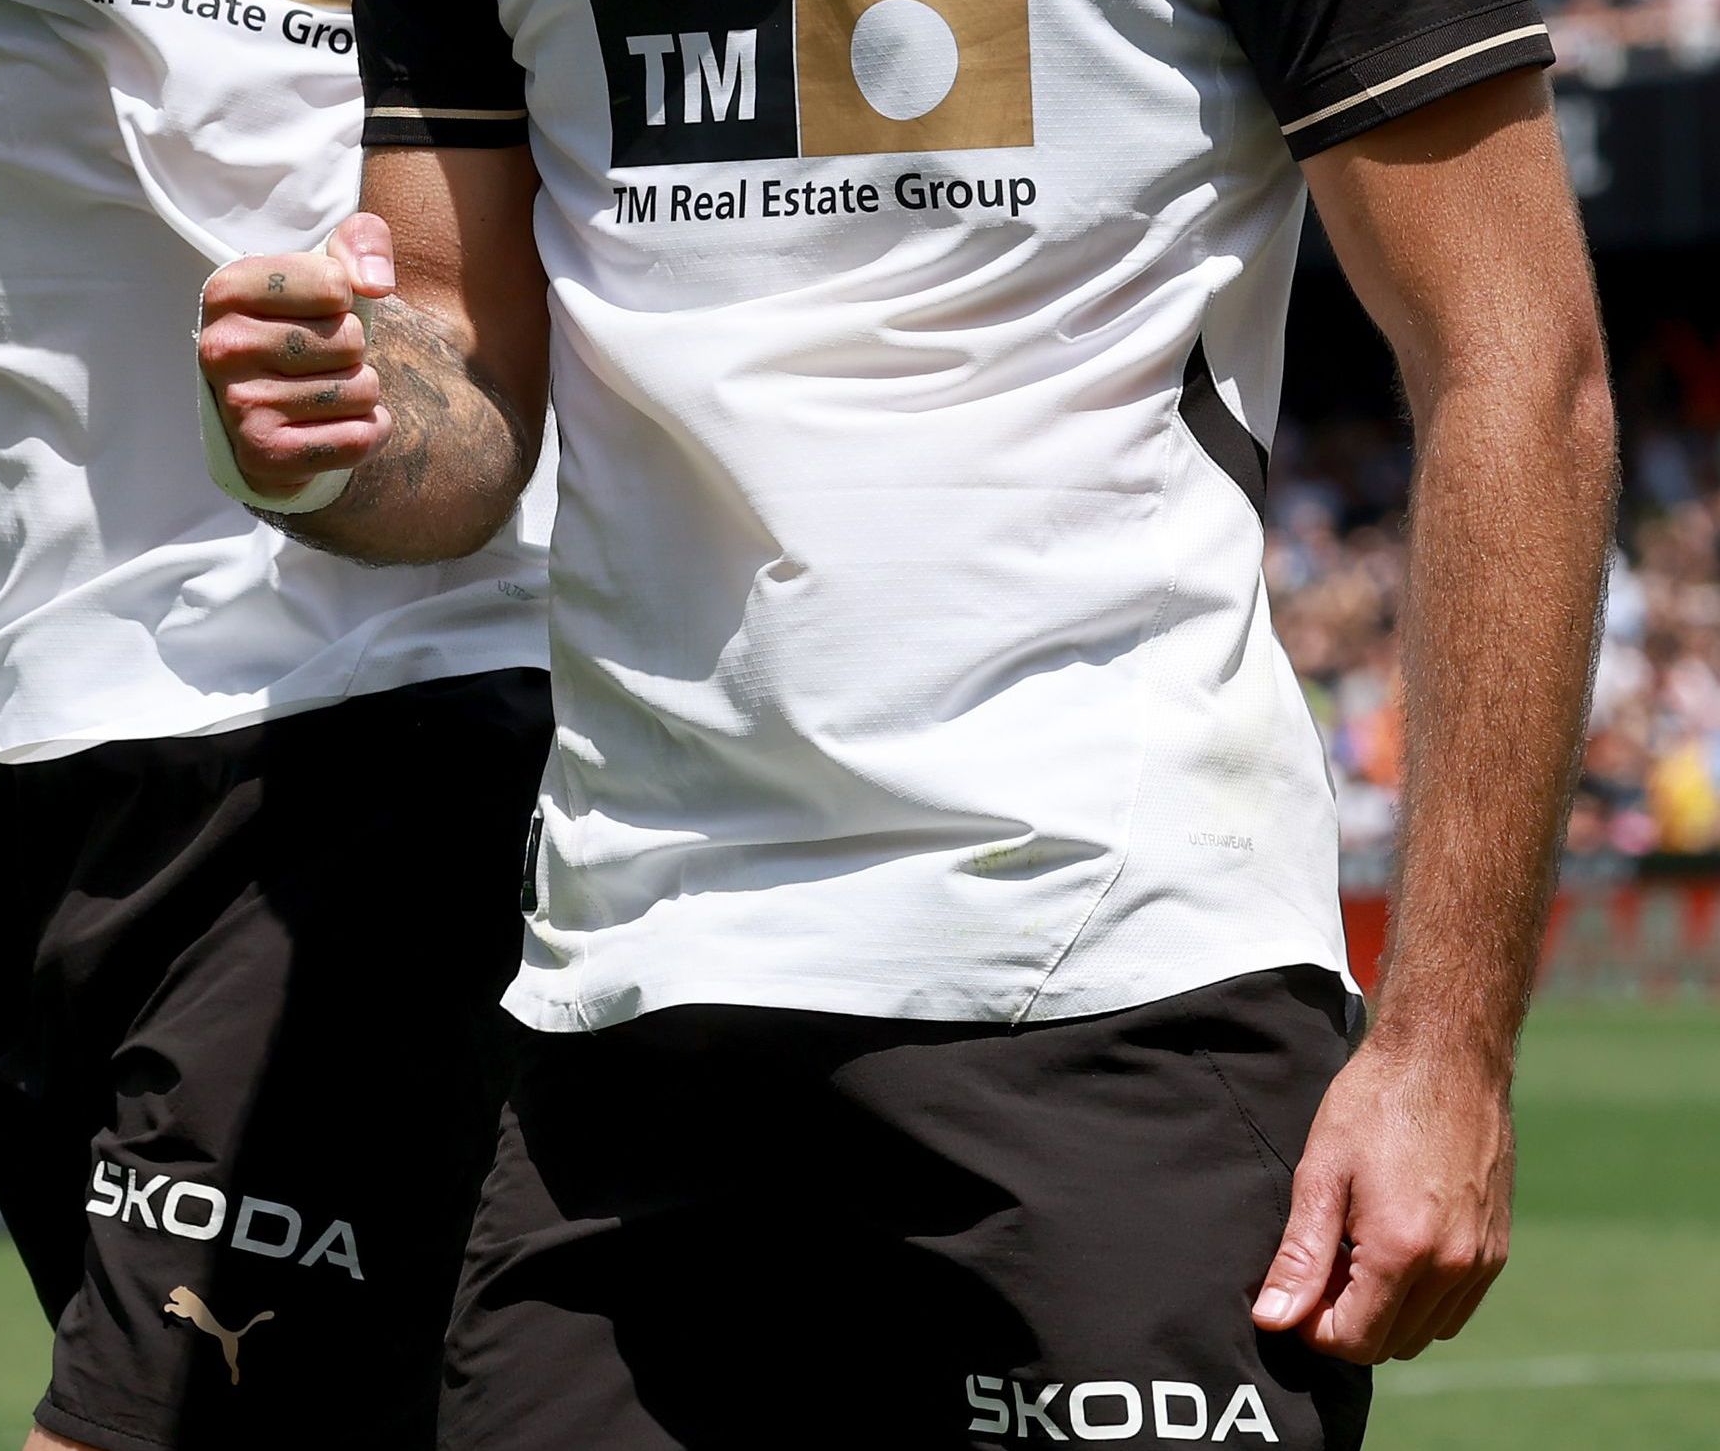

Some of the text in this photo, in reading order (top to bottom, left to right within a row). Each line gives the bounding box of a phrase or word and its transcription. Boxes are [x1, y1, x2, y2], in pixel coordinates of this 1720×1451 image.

[282, 9, 353, 55] Gro
[626, 28, 757, 126] TM
[613, 172, 1037, 224] TM Real Estate Group
